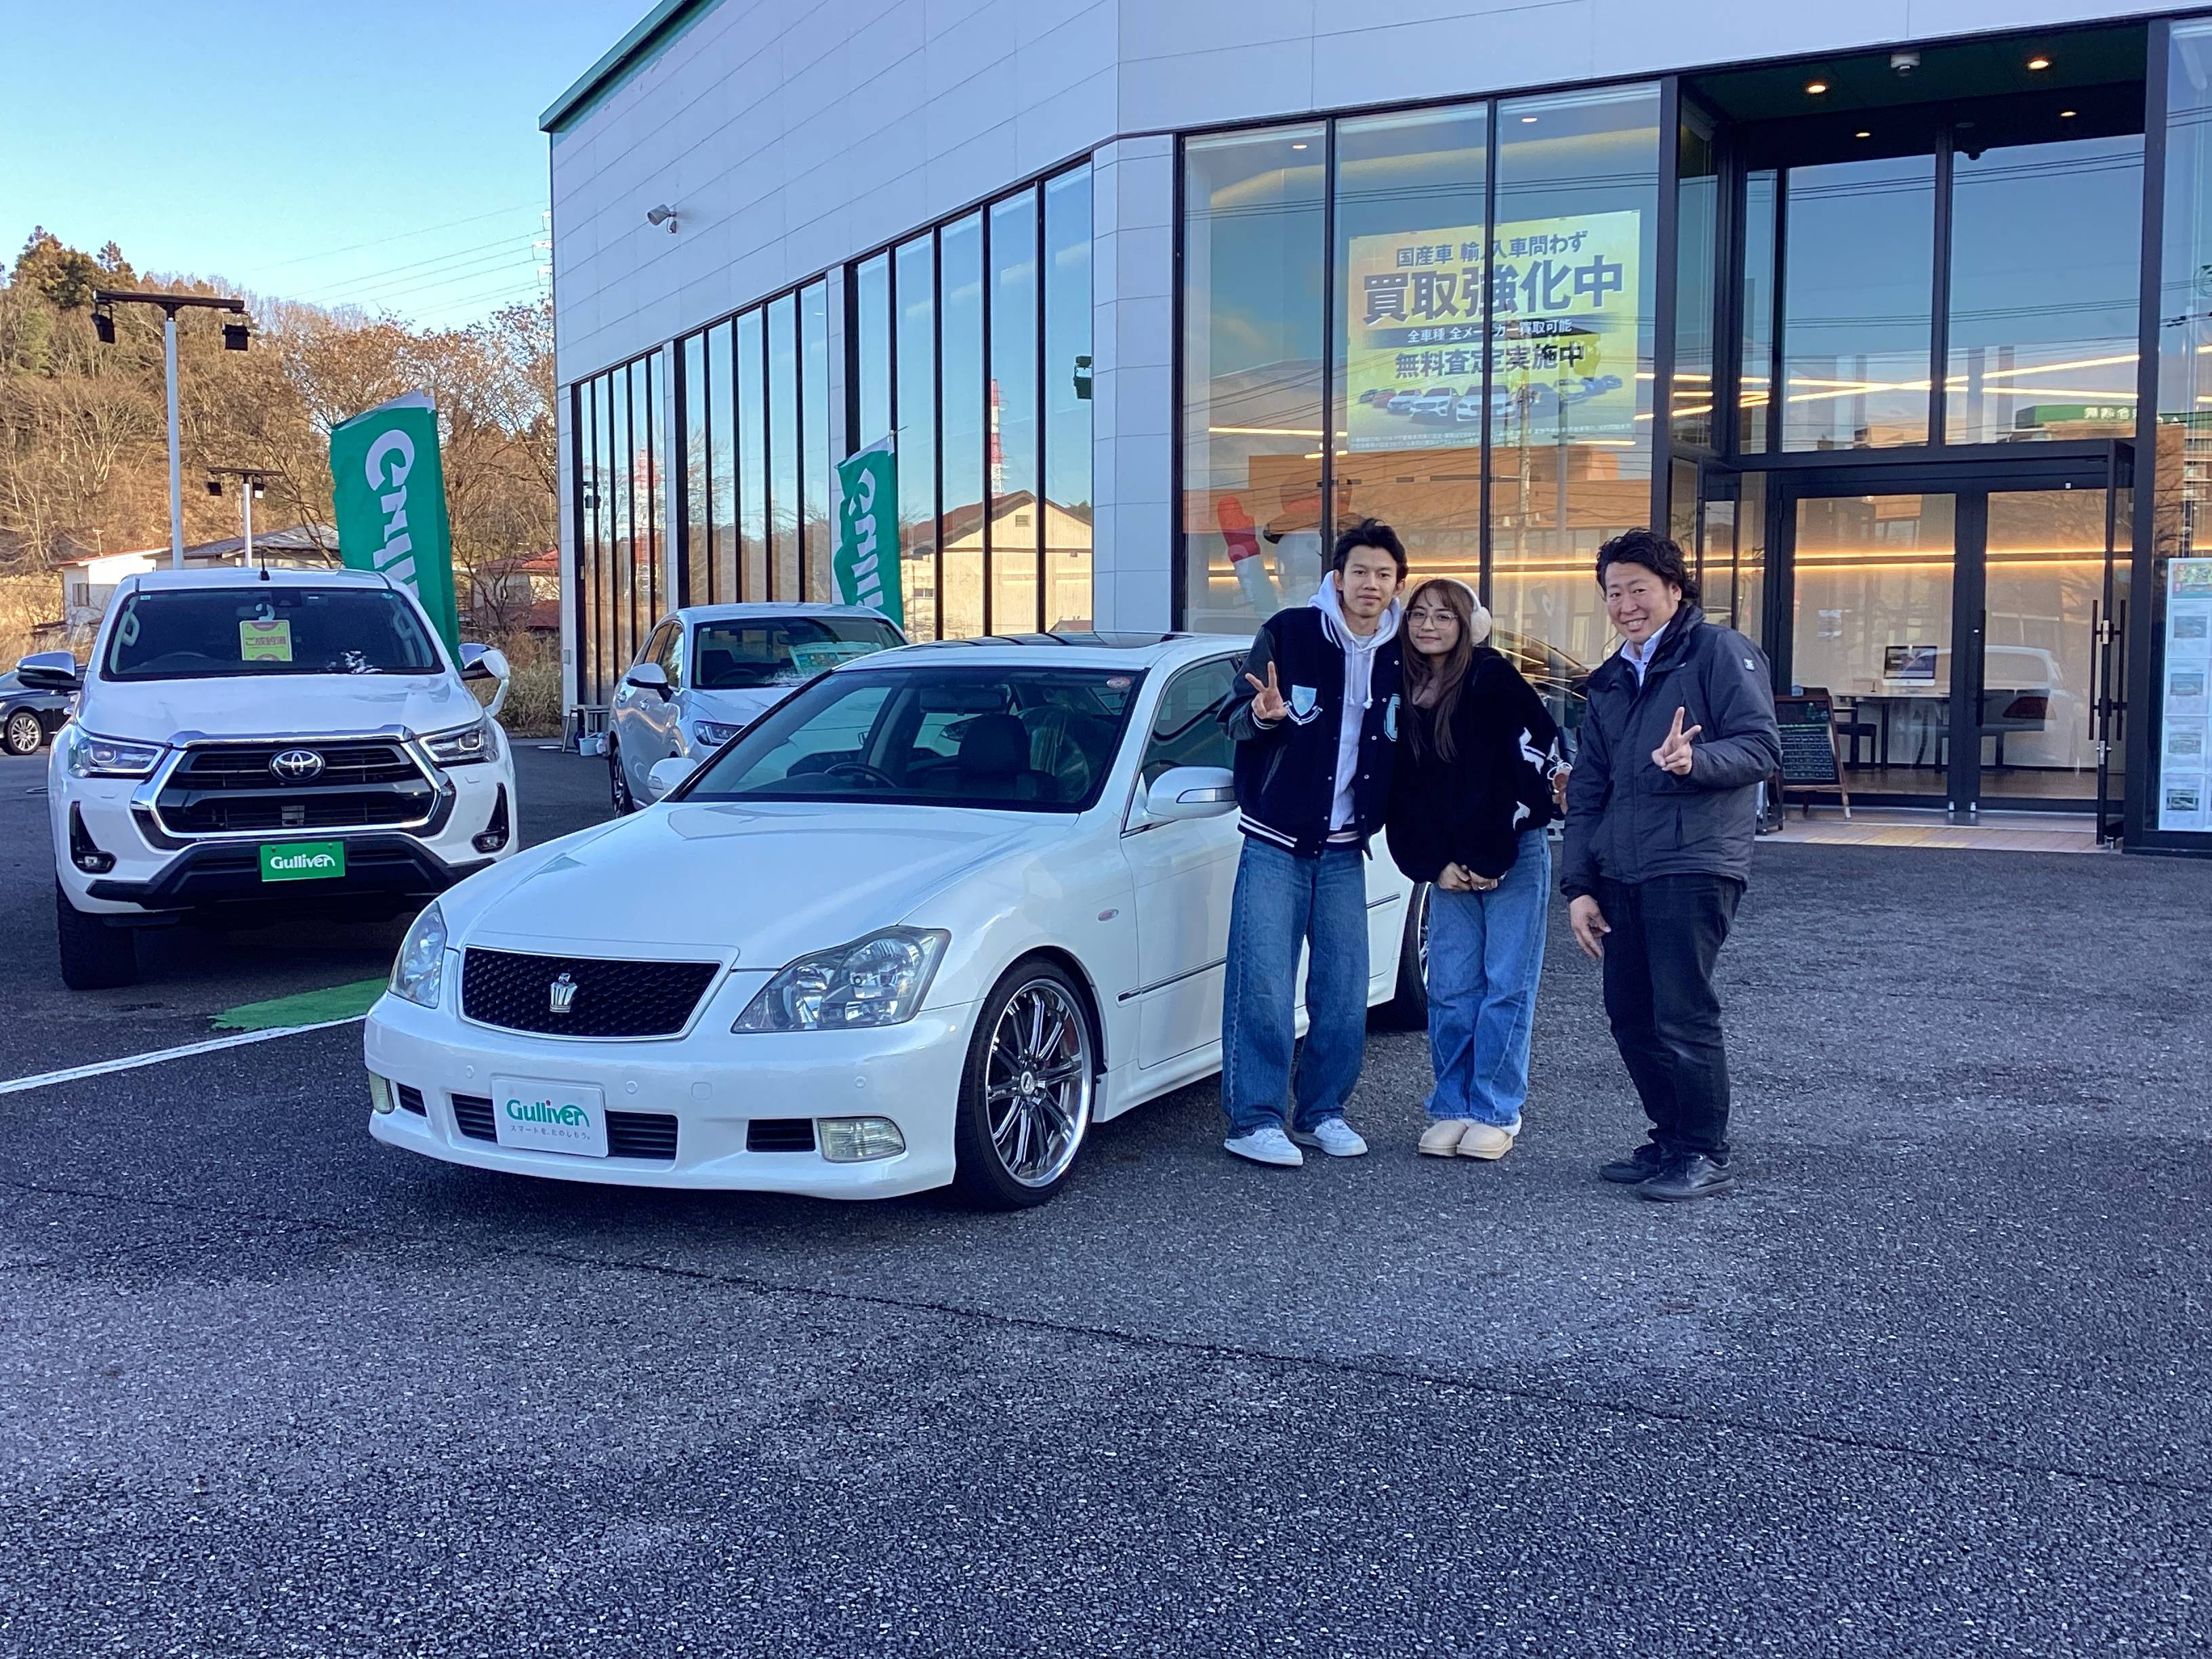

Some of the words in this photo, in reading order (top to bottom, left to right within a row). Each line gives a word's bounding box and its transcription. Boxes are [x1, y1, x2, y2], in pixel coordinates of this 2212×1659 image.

[1397, 244, 1453, 267] 国産車
[1363, 255, 1622, 324] 買取強化中
[1408, 328, 1445, 343] 全車種
[1395, 342, 1584, 378] 無料査定実施中
[270, 854, 335, 869] Gulliver
[506, 1099, 590, 1128] Gulliver
